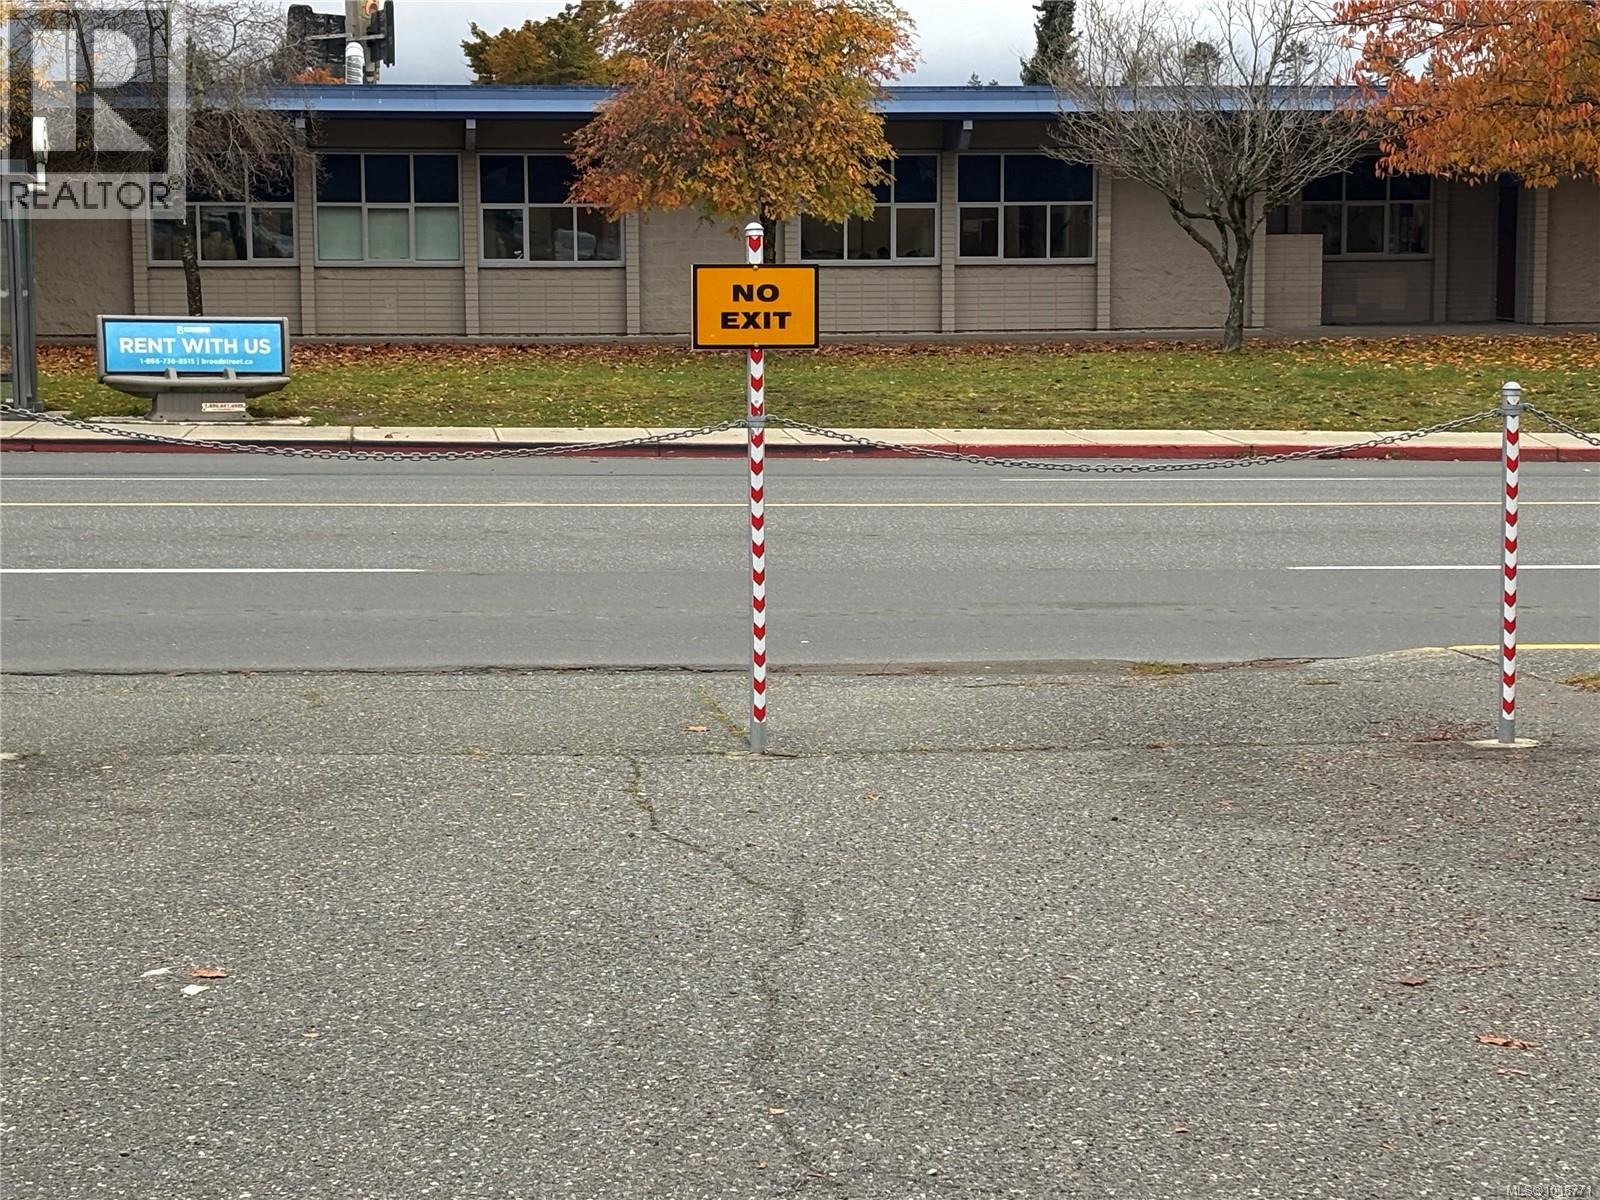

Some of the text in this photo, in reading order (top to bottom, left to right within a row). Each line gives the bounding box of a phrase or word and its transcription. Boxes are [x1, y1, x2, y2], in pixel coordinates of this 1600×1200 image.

[732, 284, 780, 303] NO
[720, 311, 792, 330] EXIT
[119, 337, 272, 355] RENT WITH US
[201, 357, 254, 366] broadstreet.ca
